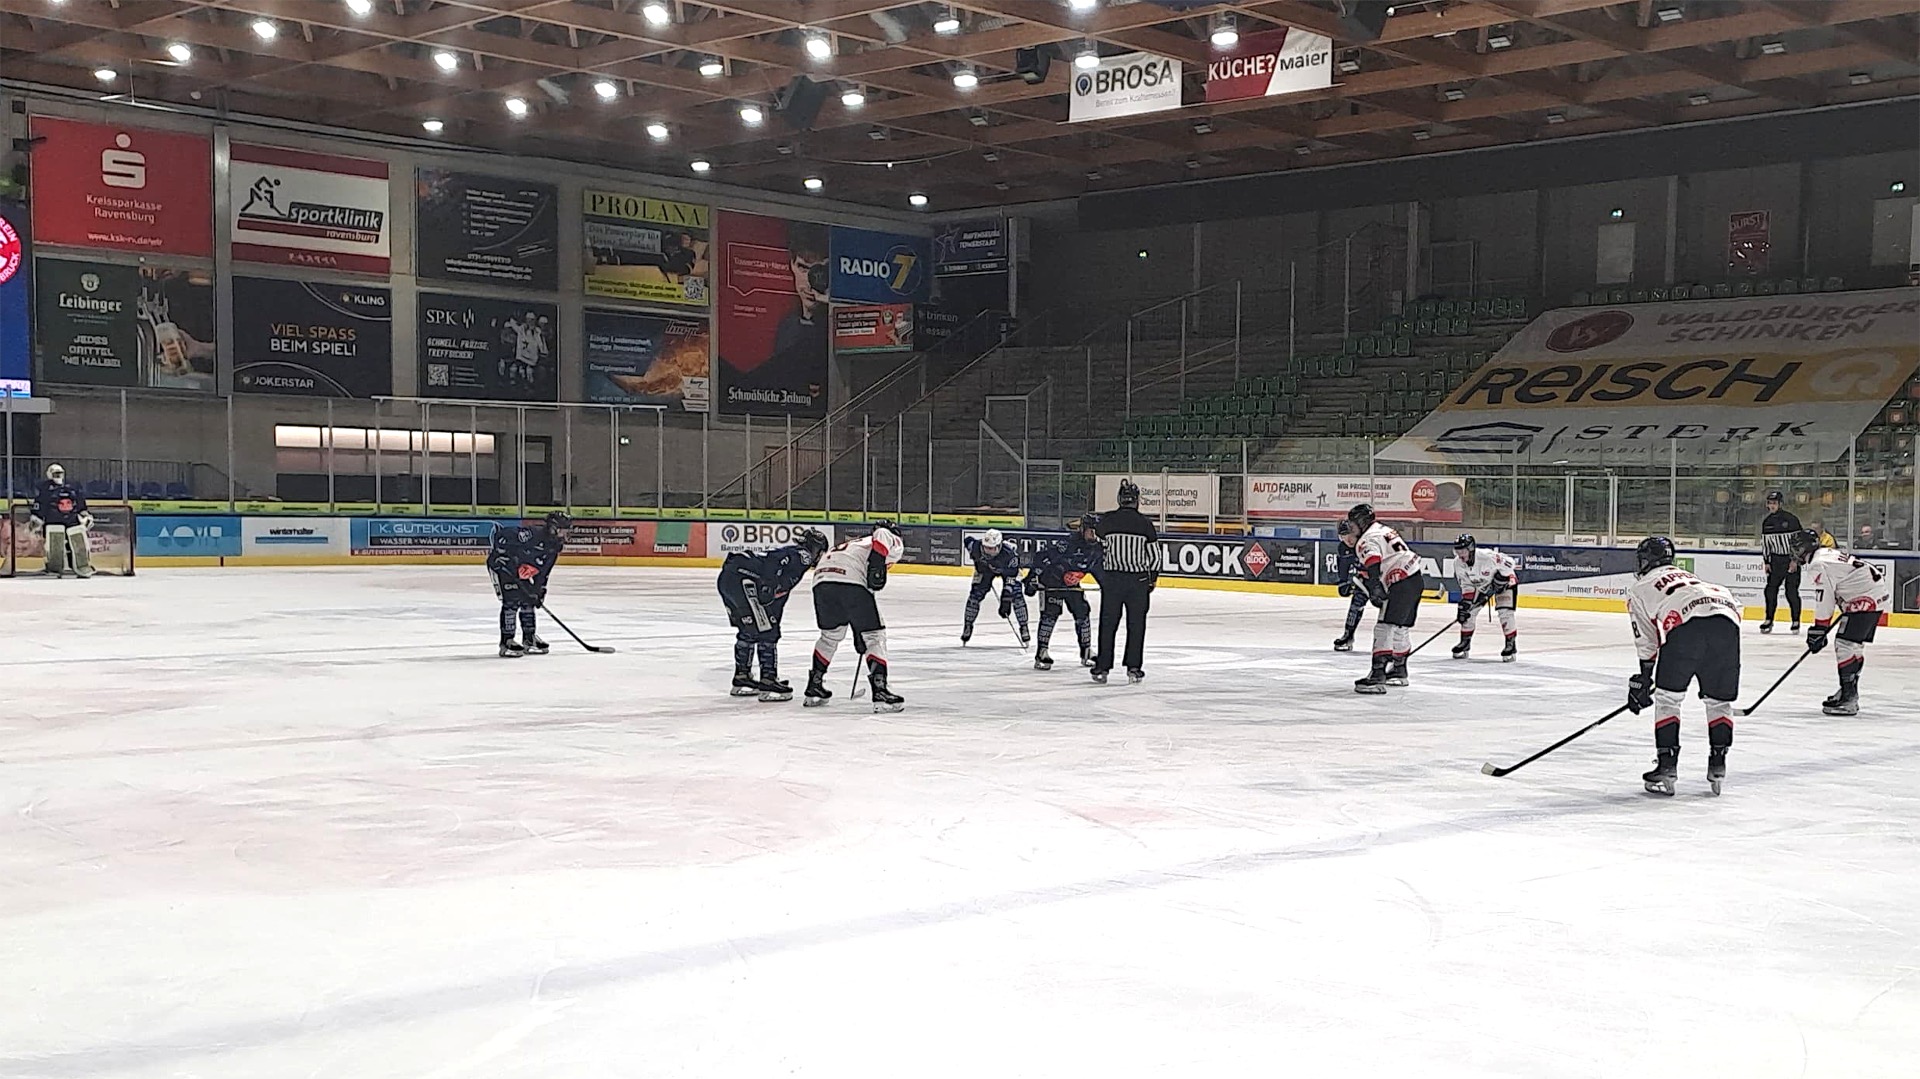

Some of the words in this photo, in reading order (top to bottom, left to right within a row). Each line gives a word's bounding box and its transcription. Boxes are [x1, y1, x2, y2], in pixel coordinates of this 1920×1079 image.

[1208, 53, 1276, 82] KÜCHE?
[1280, 51, 1329, 71] Maier
[1096, 59, 1174, 95] BROSA
[86, 194, 163, 212] Kreissparkasse
[592, 193, 701, 226] PROLANA
[94, 207, 156, 225] Ravensburg
[290, 205, 381, 229] sportklinik
[326, 230, 378, 244] ravensburg
[839, 256, 891, 280] RADIO
[890, 253, 918, 289] 7
[59, 292, 123, 314] Leibinger
[354, 294, 386, 307] KLING
[426, 308, 458, 326] SPK
[1655, 303, 1919, 326] WALDBURGER
[271, 323, 304, 337] VIEL
[308, 326, 357, 341] SPASS
[1664, 319, 1875, 344] SCHINKEN
[270, 338, 308, 353] BEIM
[312, 341, 356, 357] SPIEL!
[254, 376, 314, 389] JOKERSTAR
[728, 386, 779, 403] Schwäbische
[1575, 421, 1815, 443] STERK
[1140, 487, 1199, 498] Steueeratung
[1253, 482, 1312, 494] AUTOFABRIK
[394, 524, 479, 534] GUTEKUNST
[743, 525, 806, 544] BROS
[380, 538, 413, 546] WASSER
[457, 538, 477, 546] LUFT
[1162, 543, 1245, 575] LOCK
[1525, 554, 1556, 563] Volksbank
[1567, 585, 1592, 594] Immer
[1593, 586, 1629, 596] Powerpl
